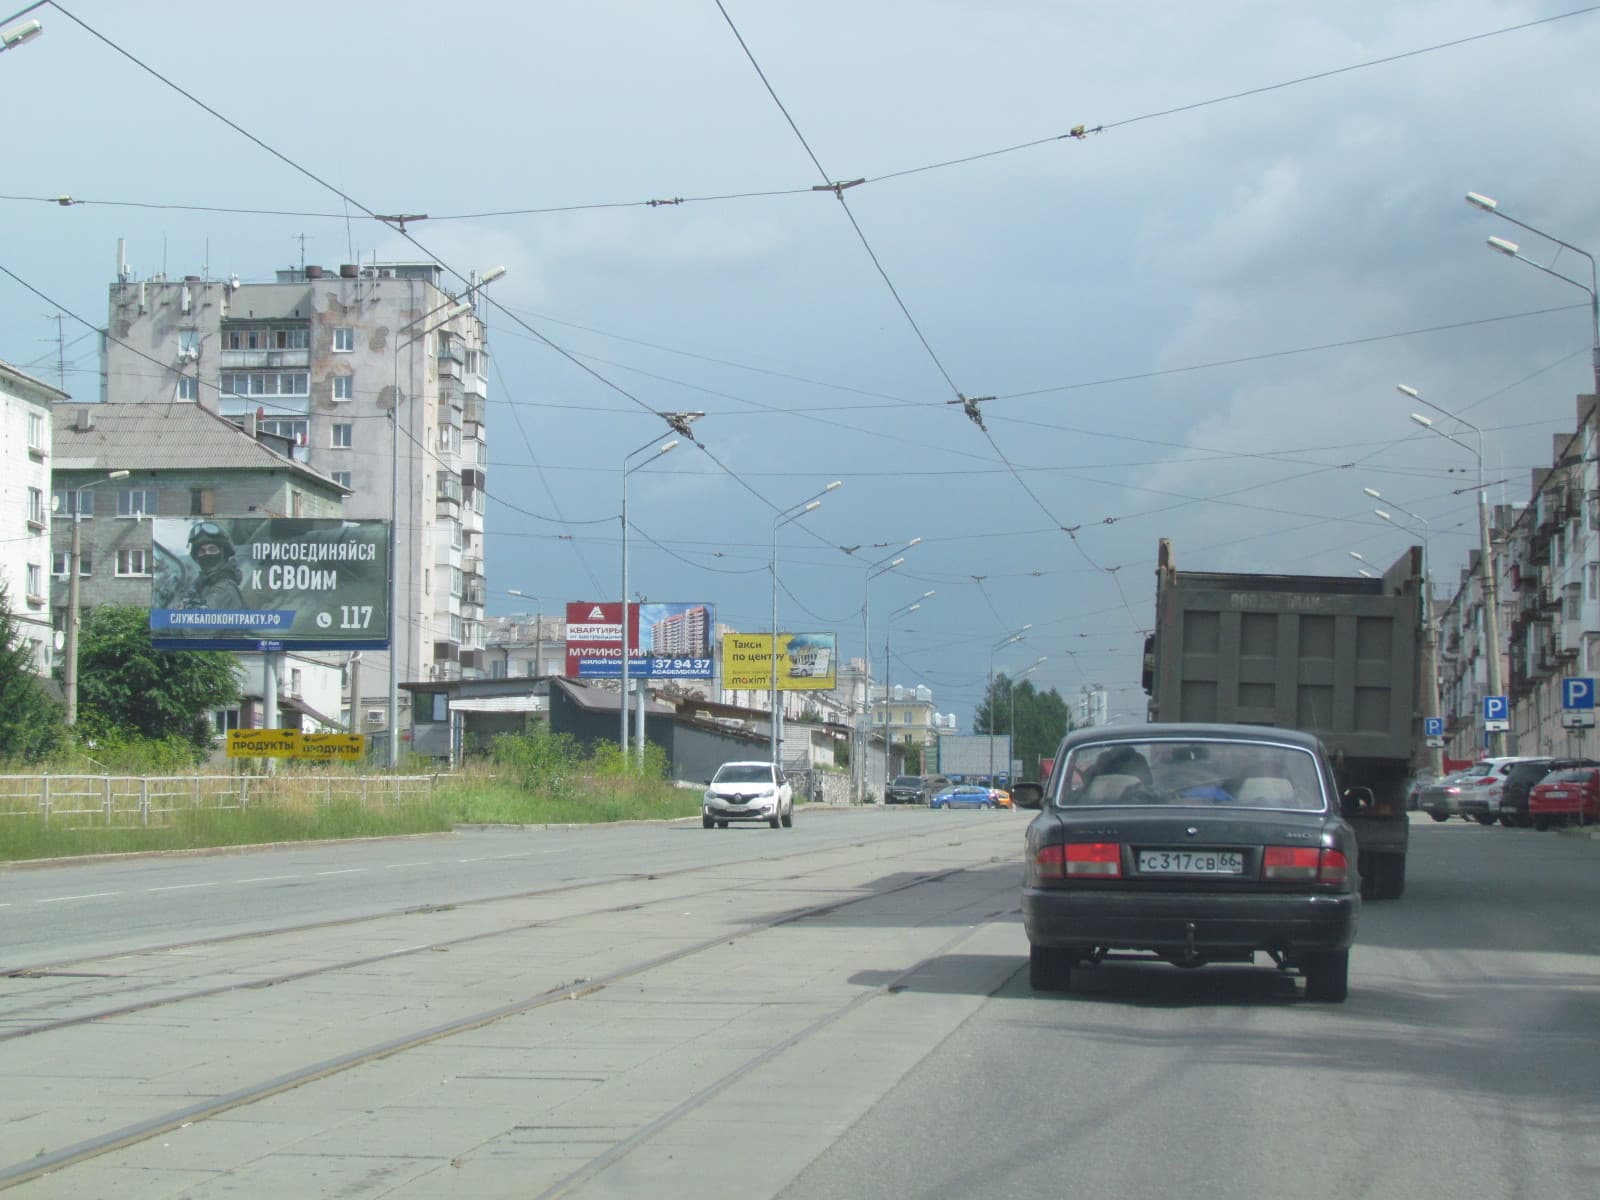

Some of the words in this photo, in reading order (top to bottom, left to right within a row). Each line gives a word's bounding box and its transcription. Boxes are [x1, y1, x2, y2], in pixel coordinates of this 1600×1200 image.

[252, 540, 376, 562] ПРИСОЕДИНЯЙСЯ
[170, 613, 281, 625] СЛУЖБАПОКОНТРАКТУ.РФ
[340, 606, 373, 629] 117
[733, 640, 762, 649] Такси
[569, 647, 647, 657] МУРИНСИЙ
[732, 653, 745, 661] по
[655, 659, 671, 668] 37
[674, 659, 691, 668] 94
[693, 659, 710, 668] 37
[732, 675, 766, 684] maxim
[232, 741, 294, 751] ПРОДУКТЫ
